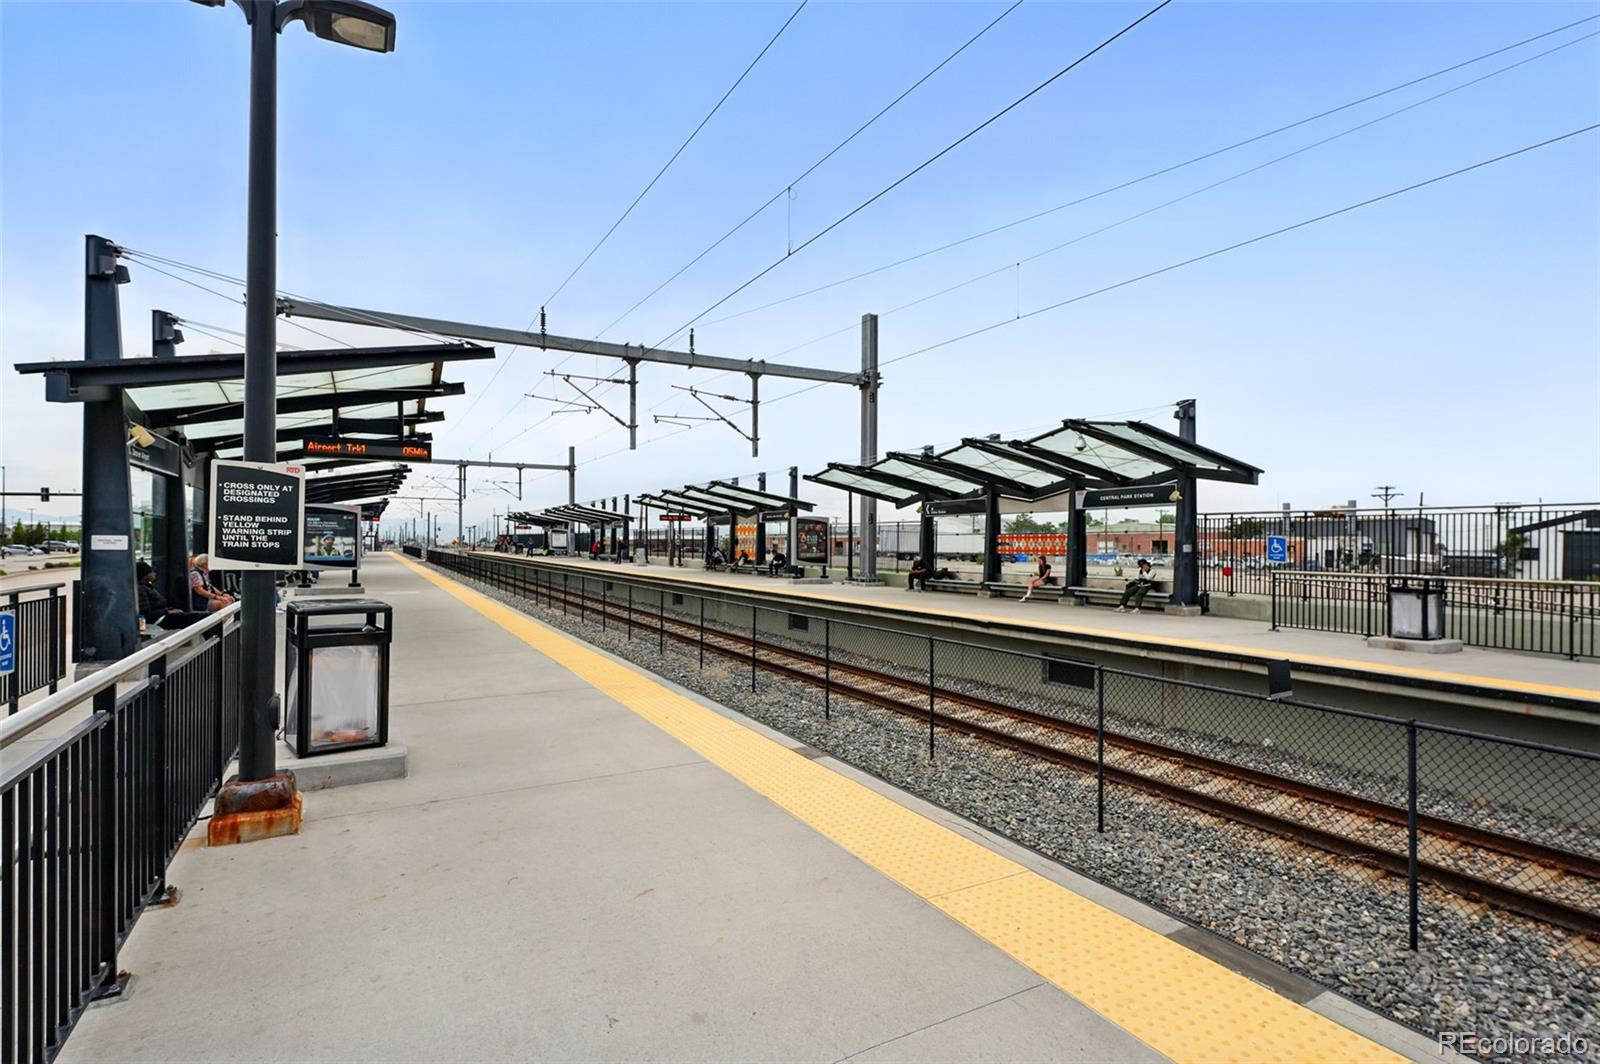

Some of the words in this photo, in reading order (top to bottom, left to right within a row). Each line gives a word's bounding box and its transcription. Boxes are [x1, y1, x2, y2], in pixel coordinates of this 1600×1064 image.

[307, 441, 341, 453] Airport
[346, 443, 366, 455] Trk1
[223, 482, 255, 490] CROSS
[223, 489, 280, 497] DESIGNATED
[223, 495, 276, 504] CROSSINGS
[251, 541, 280, 549] STOPS
